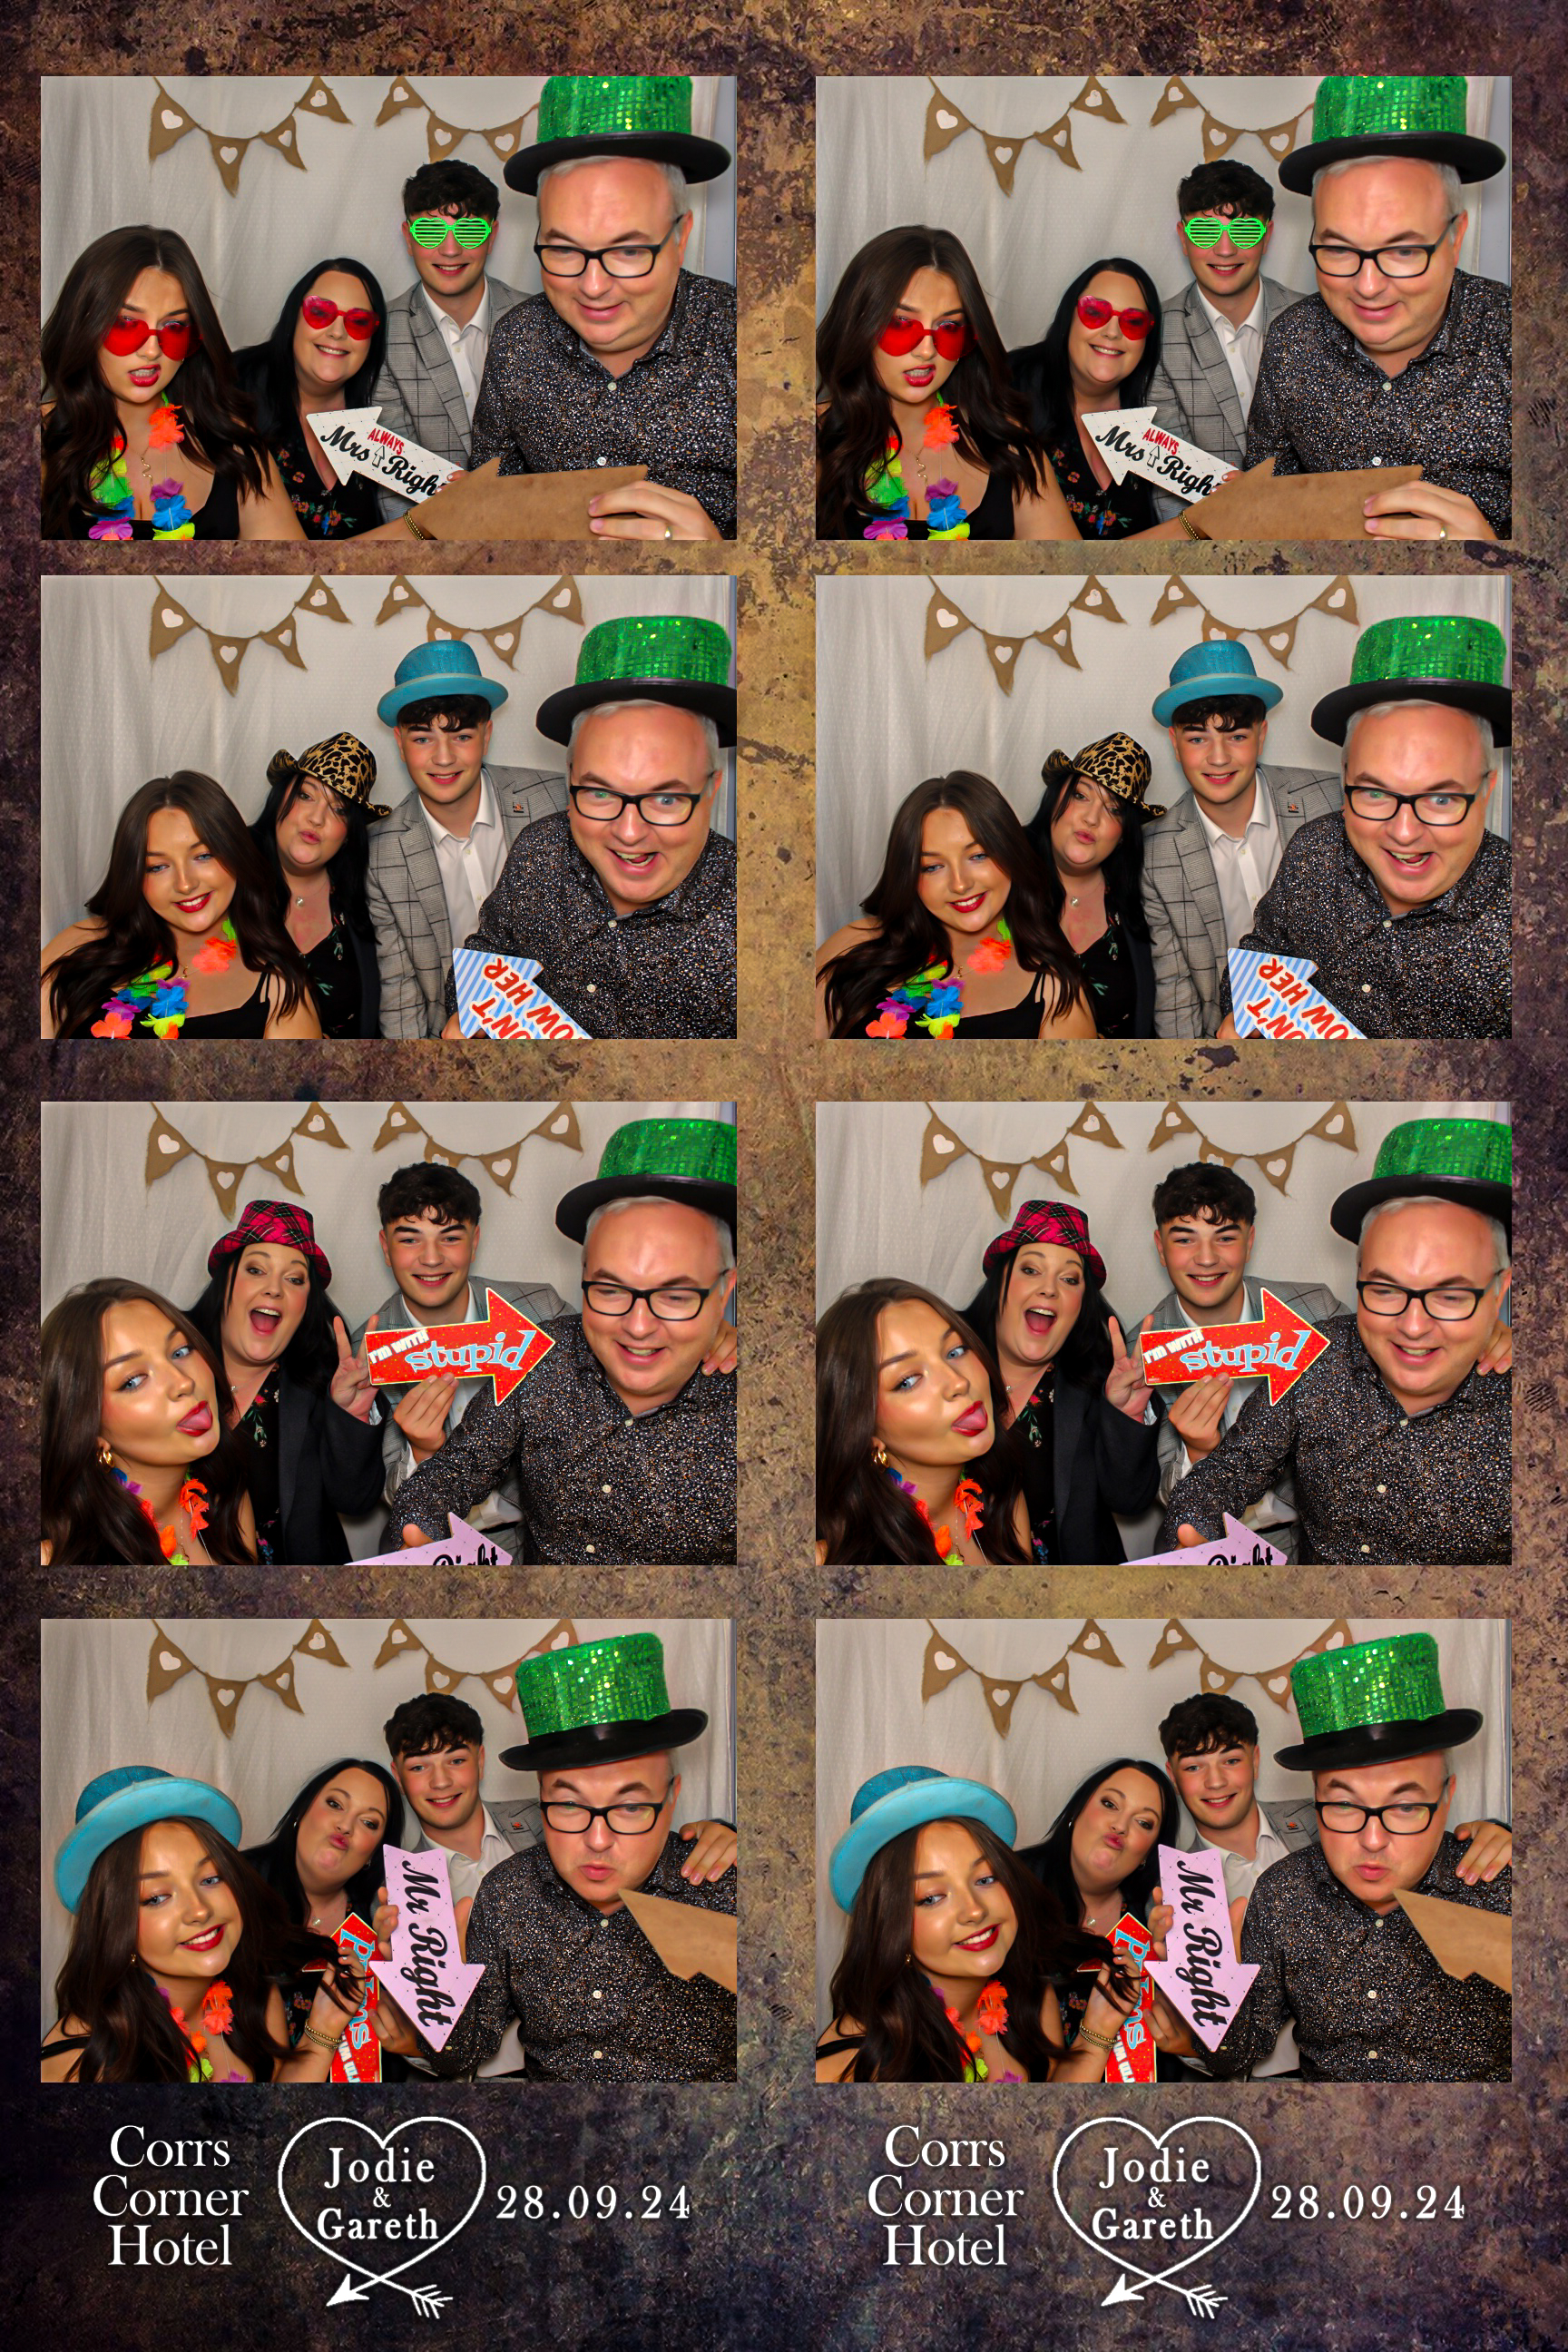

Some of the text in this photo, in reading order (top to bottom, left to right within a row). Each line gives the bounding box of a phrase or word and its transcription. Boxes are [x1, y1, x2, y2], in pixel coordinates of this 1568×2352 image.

[320, 426, 445, 495] Mrs Righ
[368, 427, 405, 456] ALWAYS
[1095, 426, 1220, 495] Mrs Righ
[1142, 427, 1180, 456] ALWAYS
[484, 957, 583, 1039] OW HER
[1259, 957, 1358, 1039] OW HER
[390, 1328, 430, 1354] WITH
[405, 1330, 537, 1373] stupid
[1165, 1328, 1205, 1354] WITH
[1180, 1330, 1312, 1373] stupid
[400, 1860, 456, 2027] Mr Right
[1175, 1860, 1231, 2027] Mr Right
